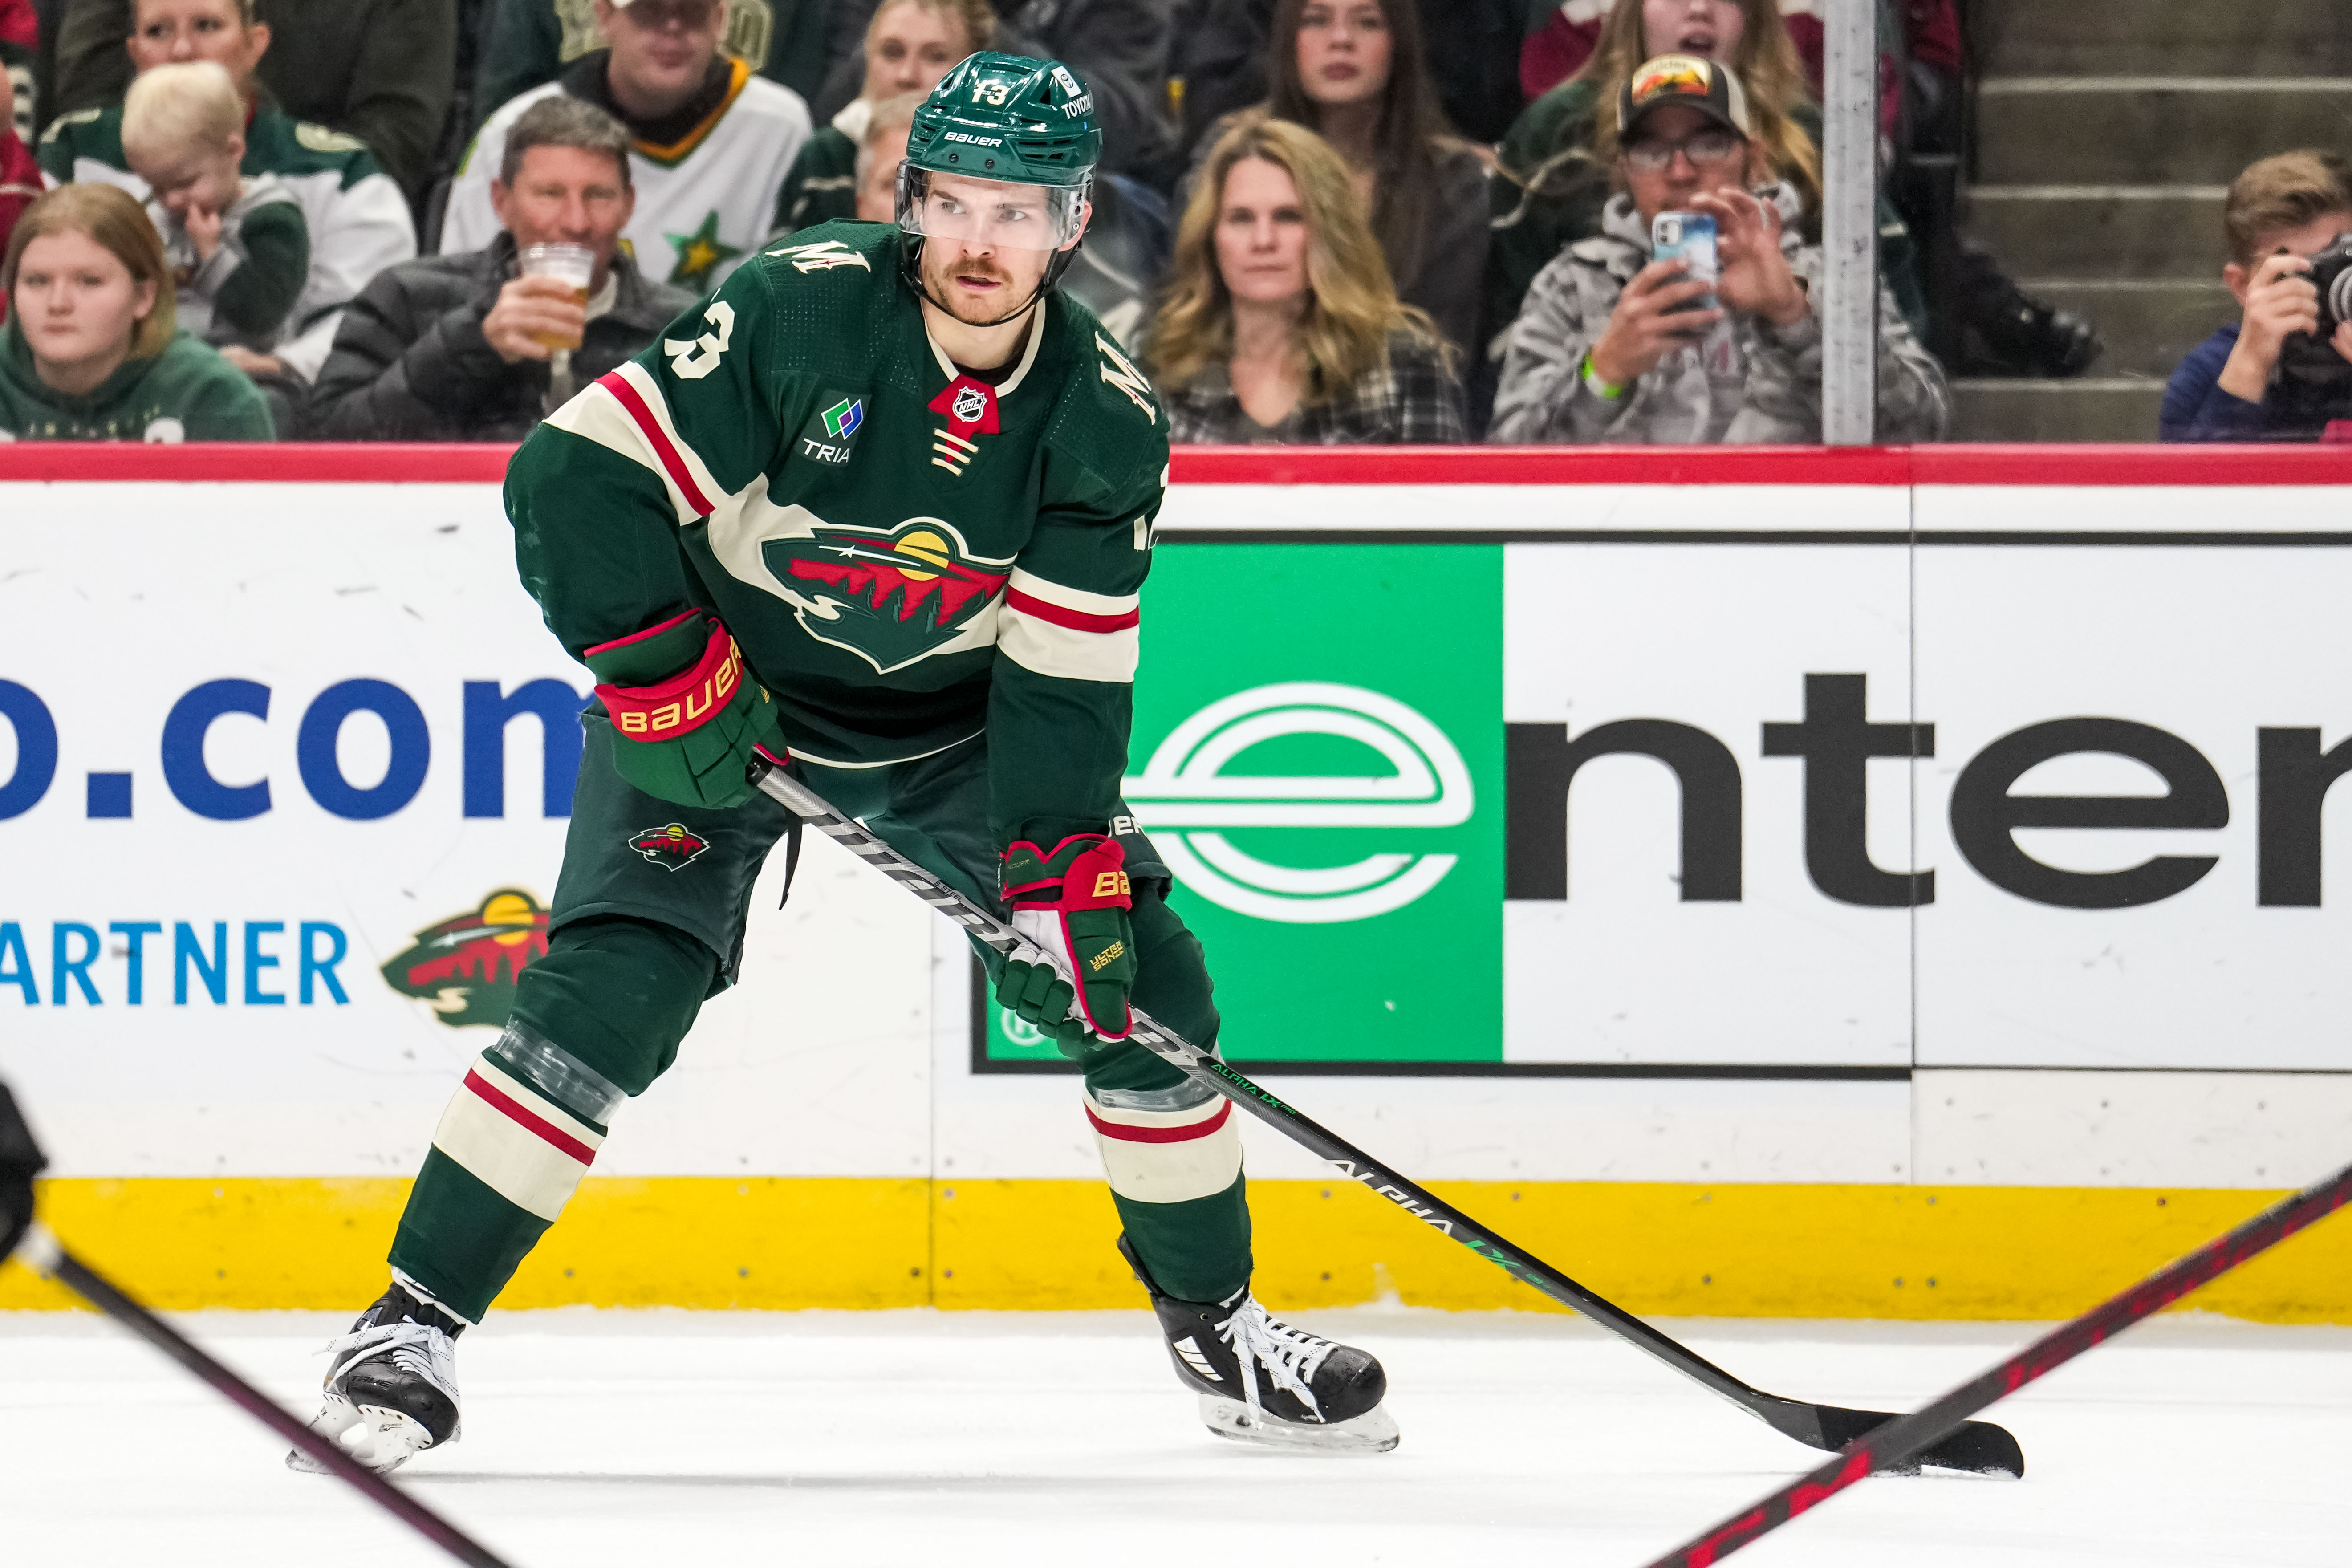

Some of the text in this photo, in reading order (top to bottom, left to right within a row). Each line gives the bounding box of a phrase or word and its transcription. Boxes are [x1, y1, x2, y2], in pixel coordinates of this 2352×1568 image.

[1061, 93, 1091, 119] TOYOTA
[944, 132, 1003, 147] BAUER
[958, 399, 980, 412] NHL
[803, 438, 850, 463] TRIA
[941, 886, 962, 902] STEEL
[1089, 941, 1123, 966] ULTRA
[1210, 1064, 1257, 1095] ALPHA
[1280, 1104, 1296, 1115] PRO
[1321, 1159, 1453, 1235] ALPHA
